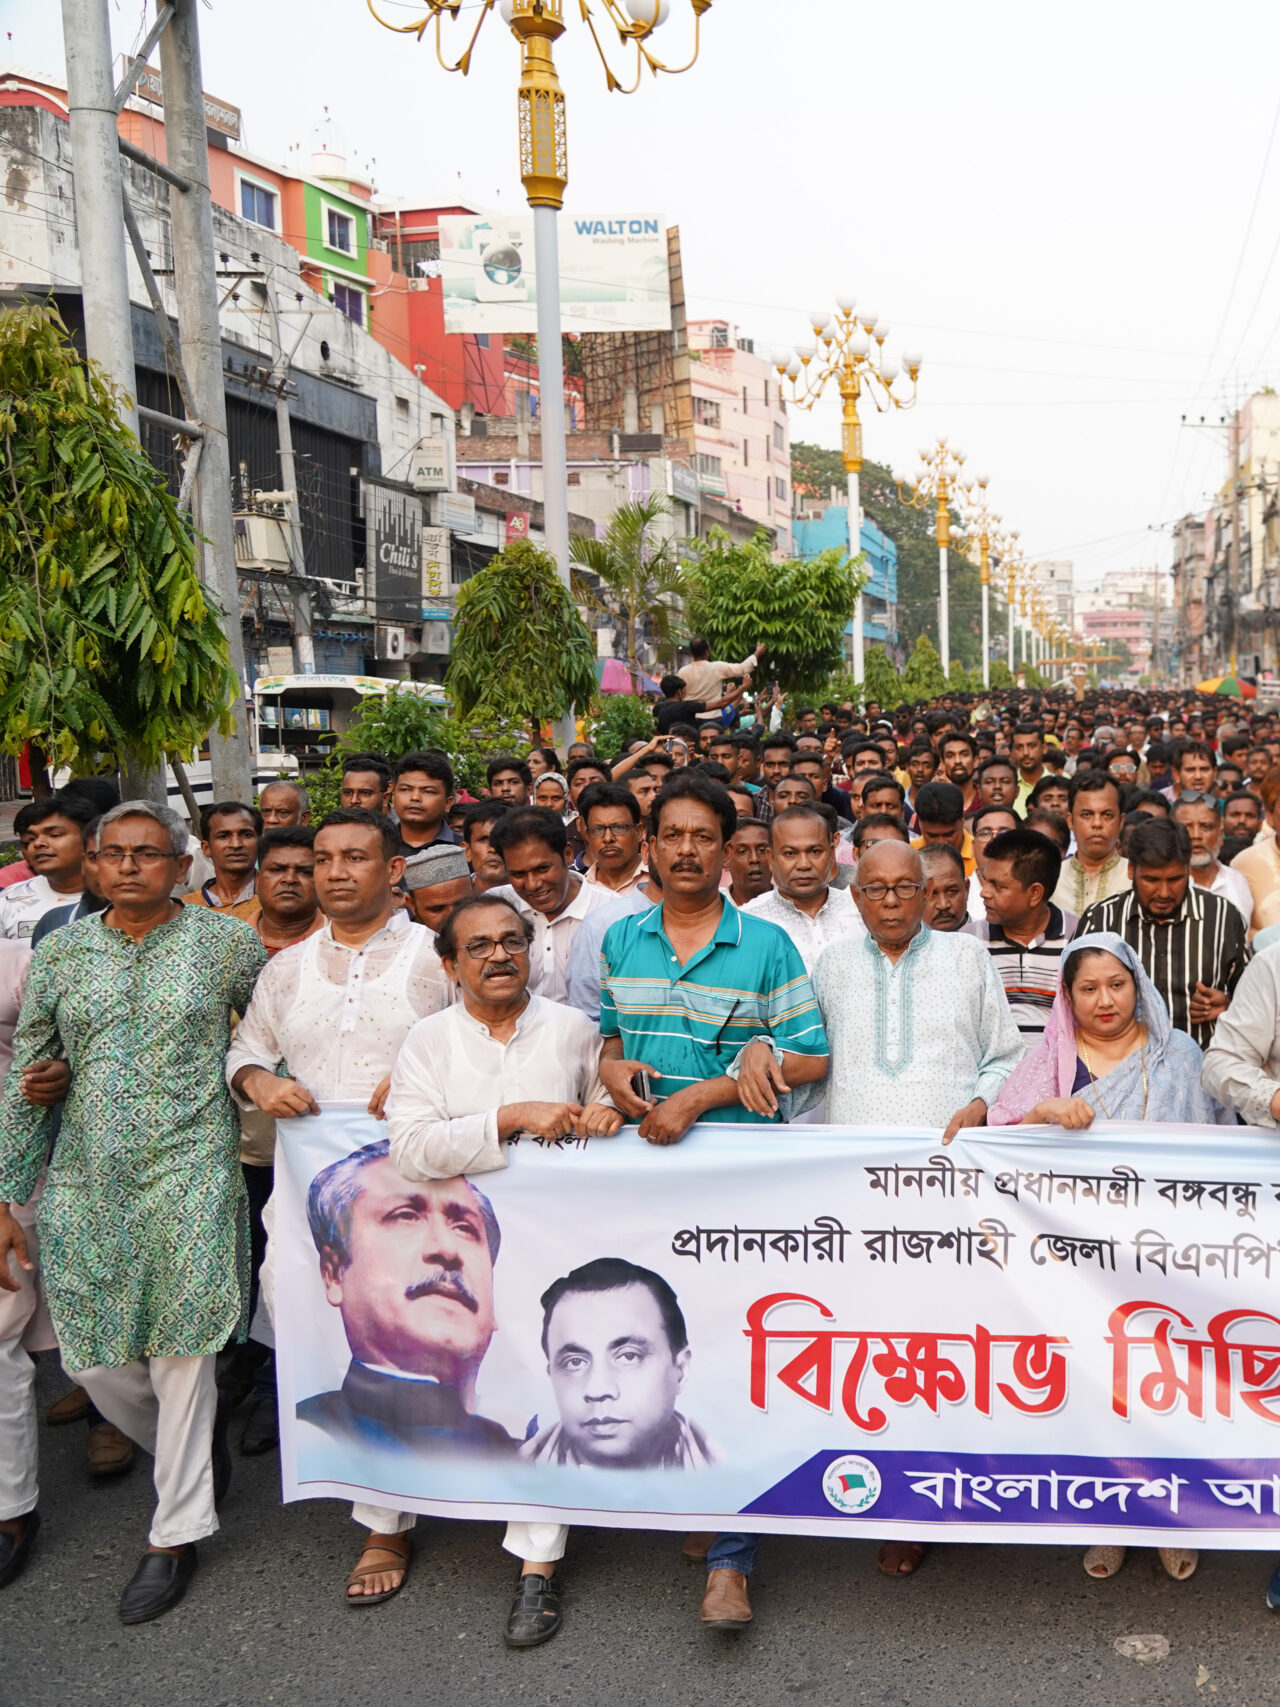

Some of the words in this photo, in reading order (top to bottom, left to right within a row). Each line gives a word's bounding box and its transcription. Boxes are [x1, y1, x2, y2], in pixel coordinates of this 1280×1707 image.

[575, 219, 658, 235] WALTON
[592, 236, 625, 245] Washing
[628, 236, 659, 244] Machine
[417, 467, 443, 476] ATM
[864, 1155, 984, 1198] মাননীয়
[995, 1165, 1145, 1208] প্রধানমন্ত্রী
[1154, 1178, 1261, 1221] বঙ্গবন্ধু
[671, 1216, 852, 1263] প্রদানকারী
[861, 1218, 1016, 1270] রাজশাহী
[1031, 1234, 1120, 1271] জেলা
[742, 1290, 1072, 1437] বিক্ষোভ
[902, 1468, 1186, 1517] বাংলাদেশ
